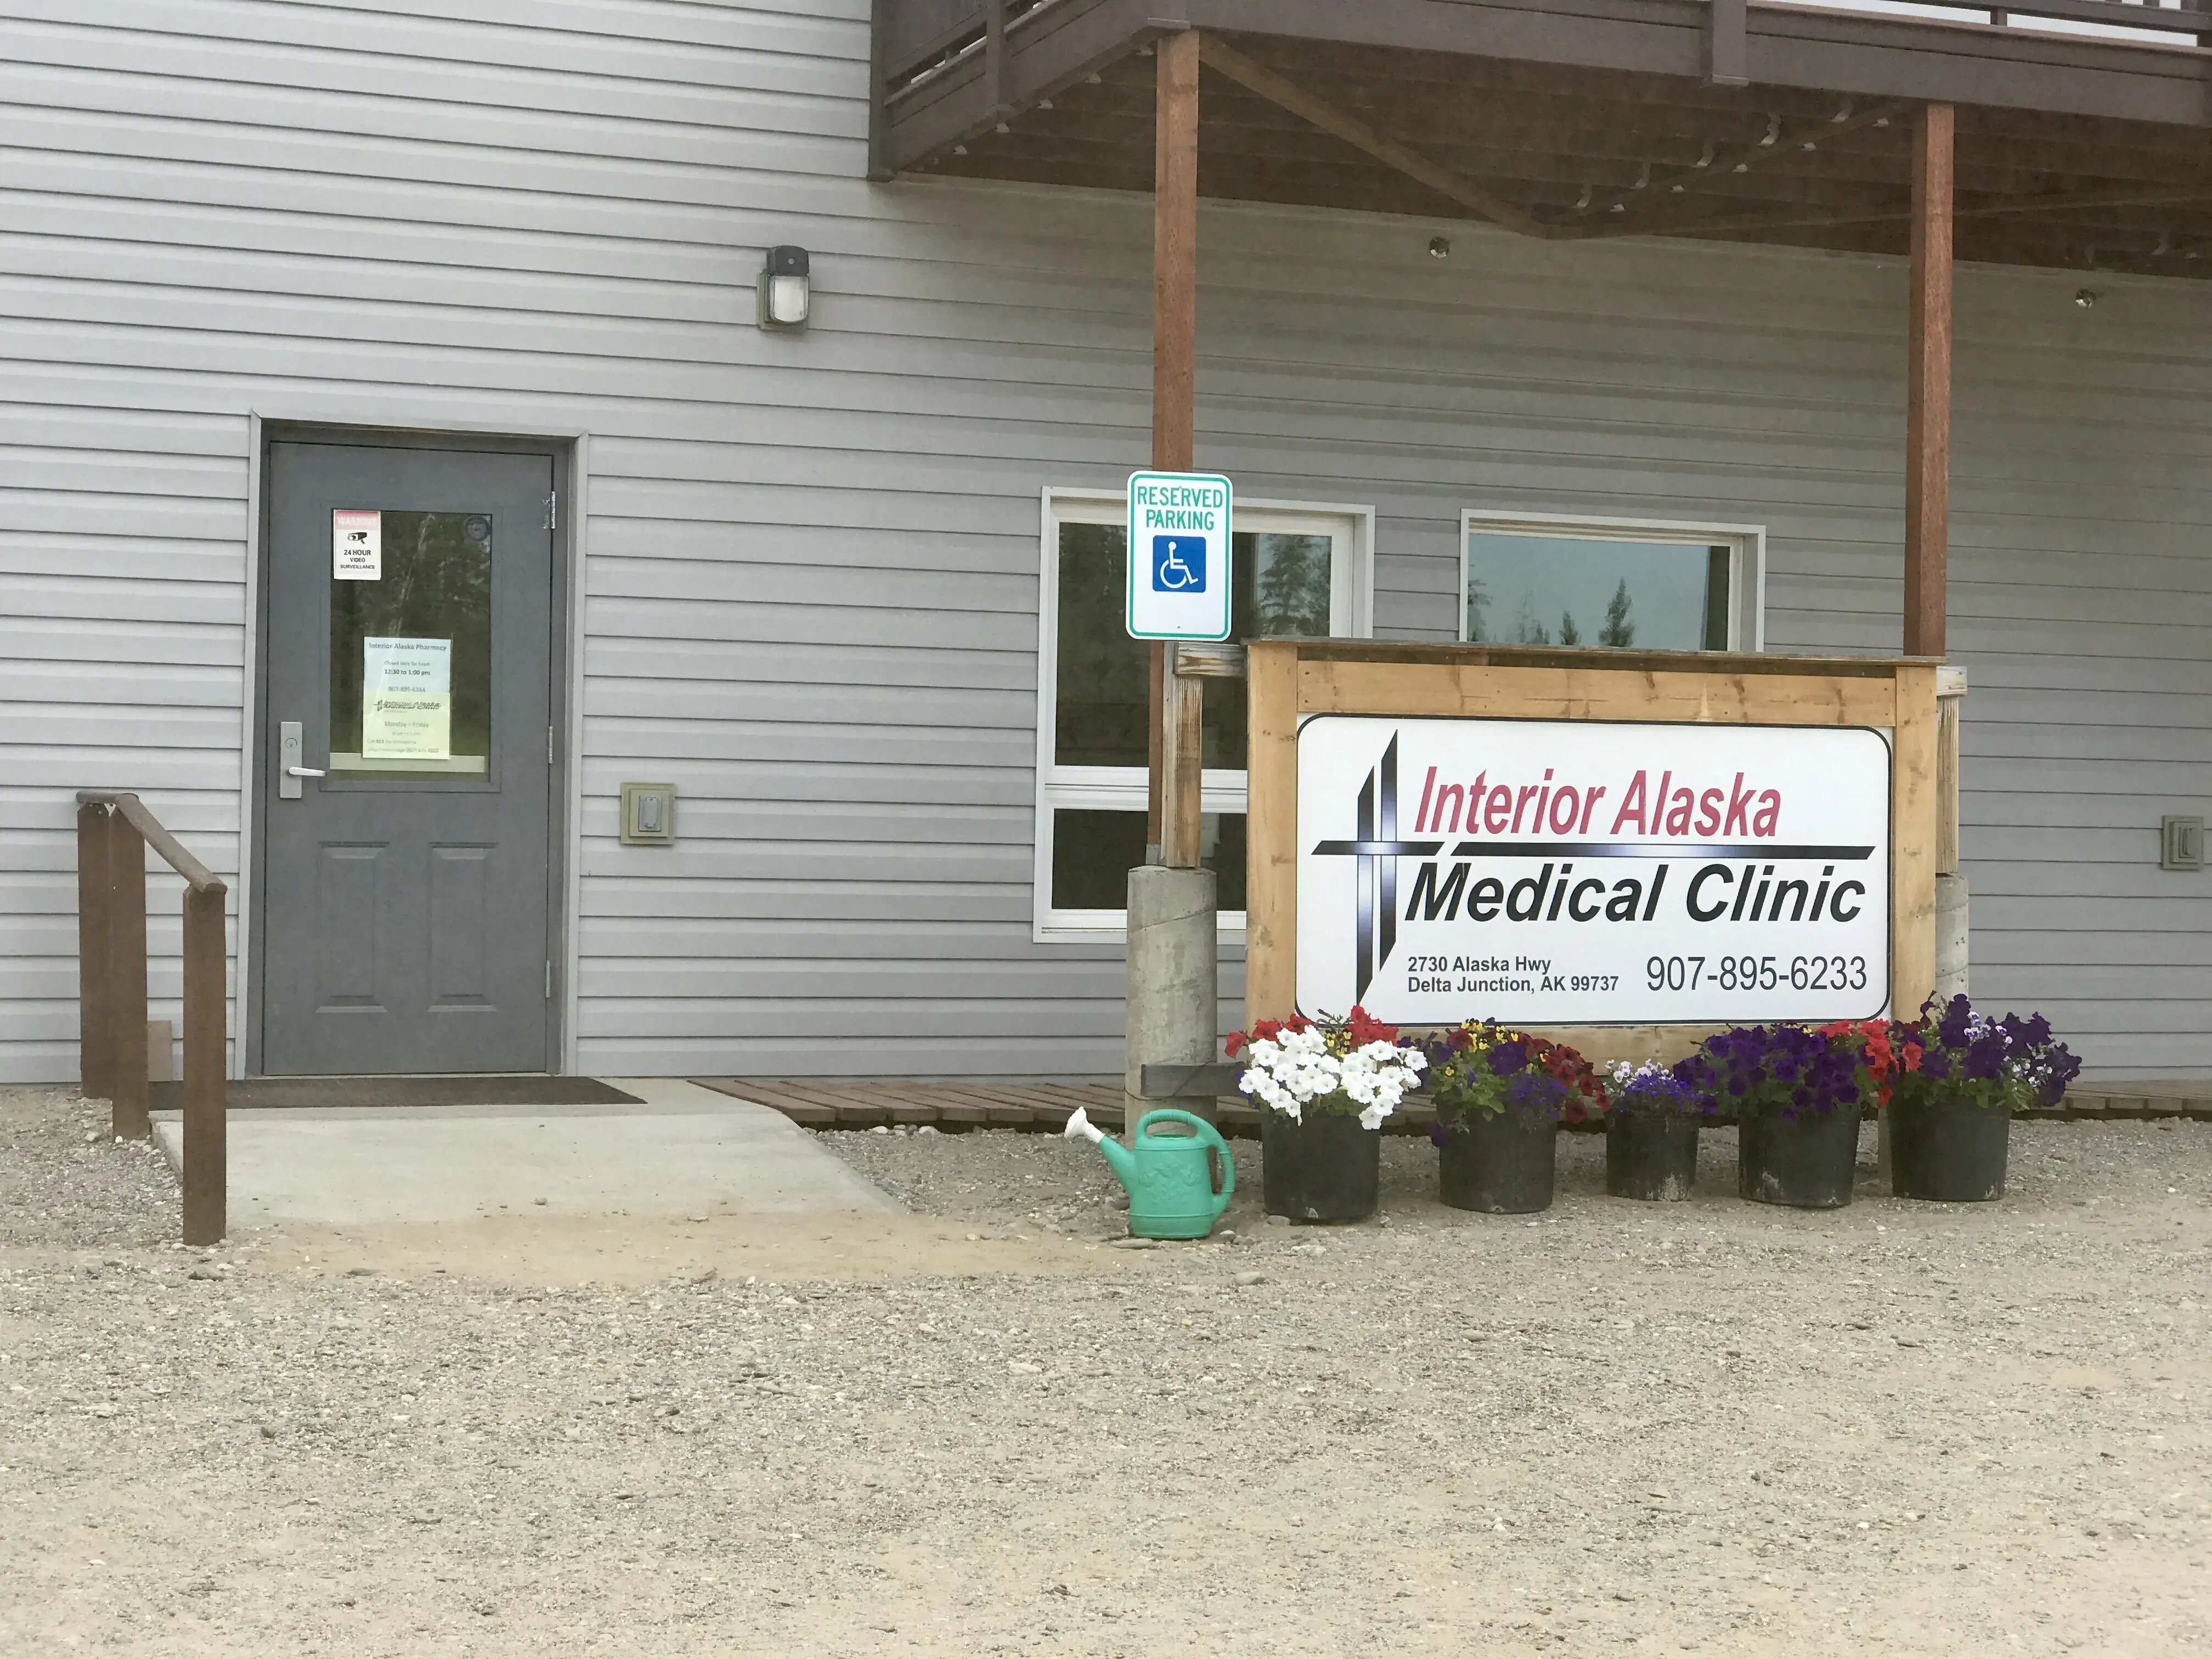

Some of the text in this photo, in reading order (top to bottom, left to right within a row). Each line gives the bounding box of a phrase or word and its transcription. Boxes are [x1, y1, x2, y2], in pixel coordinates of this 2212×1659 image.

[1137, 486, 1223, 508] RESERVED
[336, 516, 378, 527] WARNING
[1146, 509, 1215, 531] PARKING
[1413, 766, 1782, 838] Interior Alaska
[1404, 862, 1866, 923] Medical Clinic
[1407, 956, 1551, 975] 2730 Alaska Hwy
[1645, 956, 1867, 991] 907-895-6233
[1407, 975, 1620, 995] Delta Junction, AK 99737
